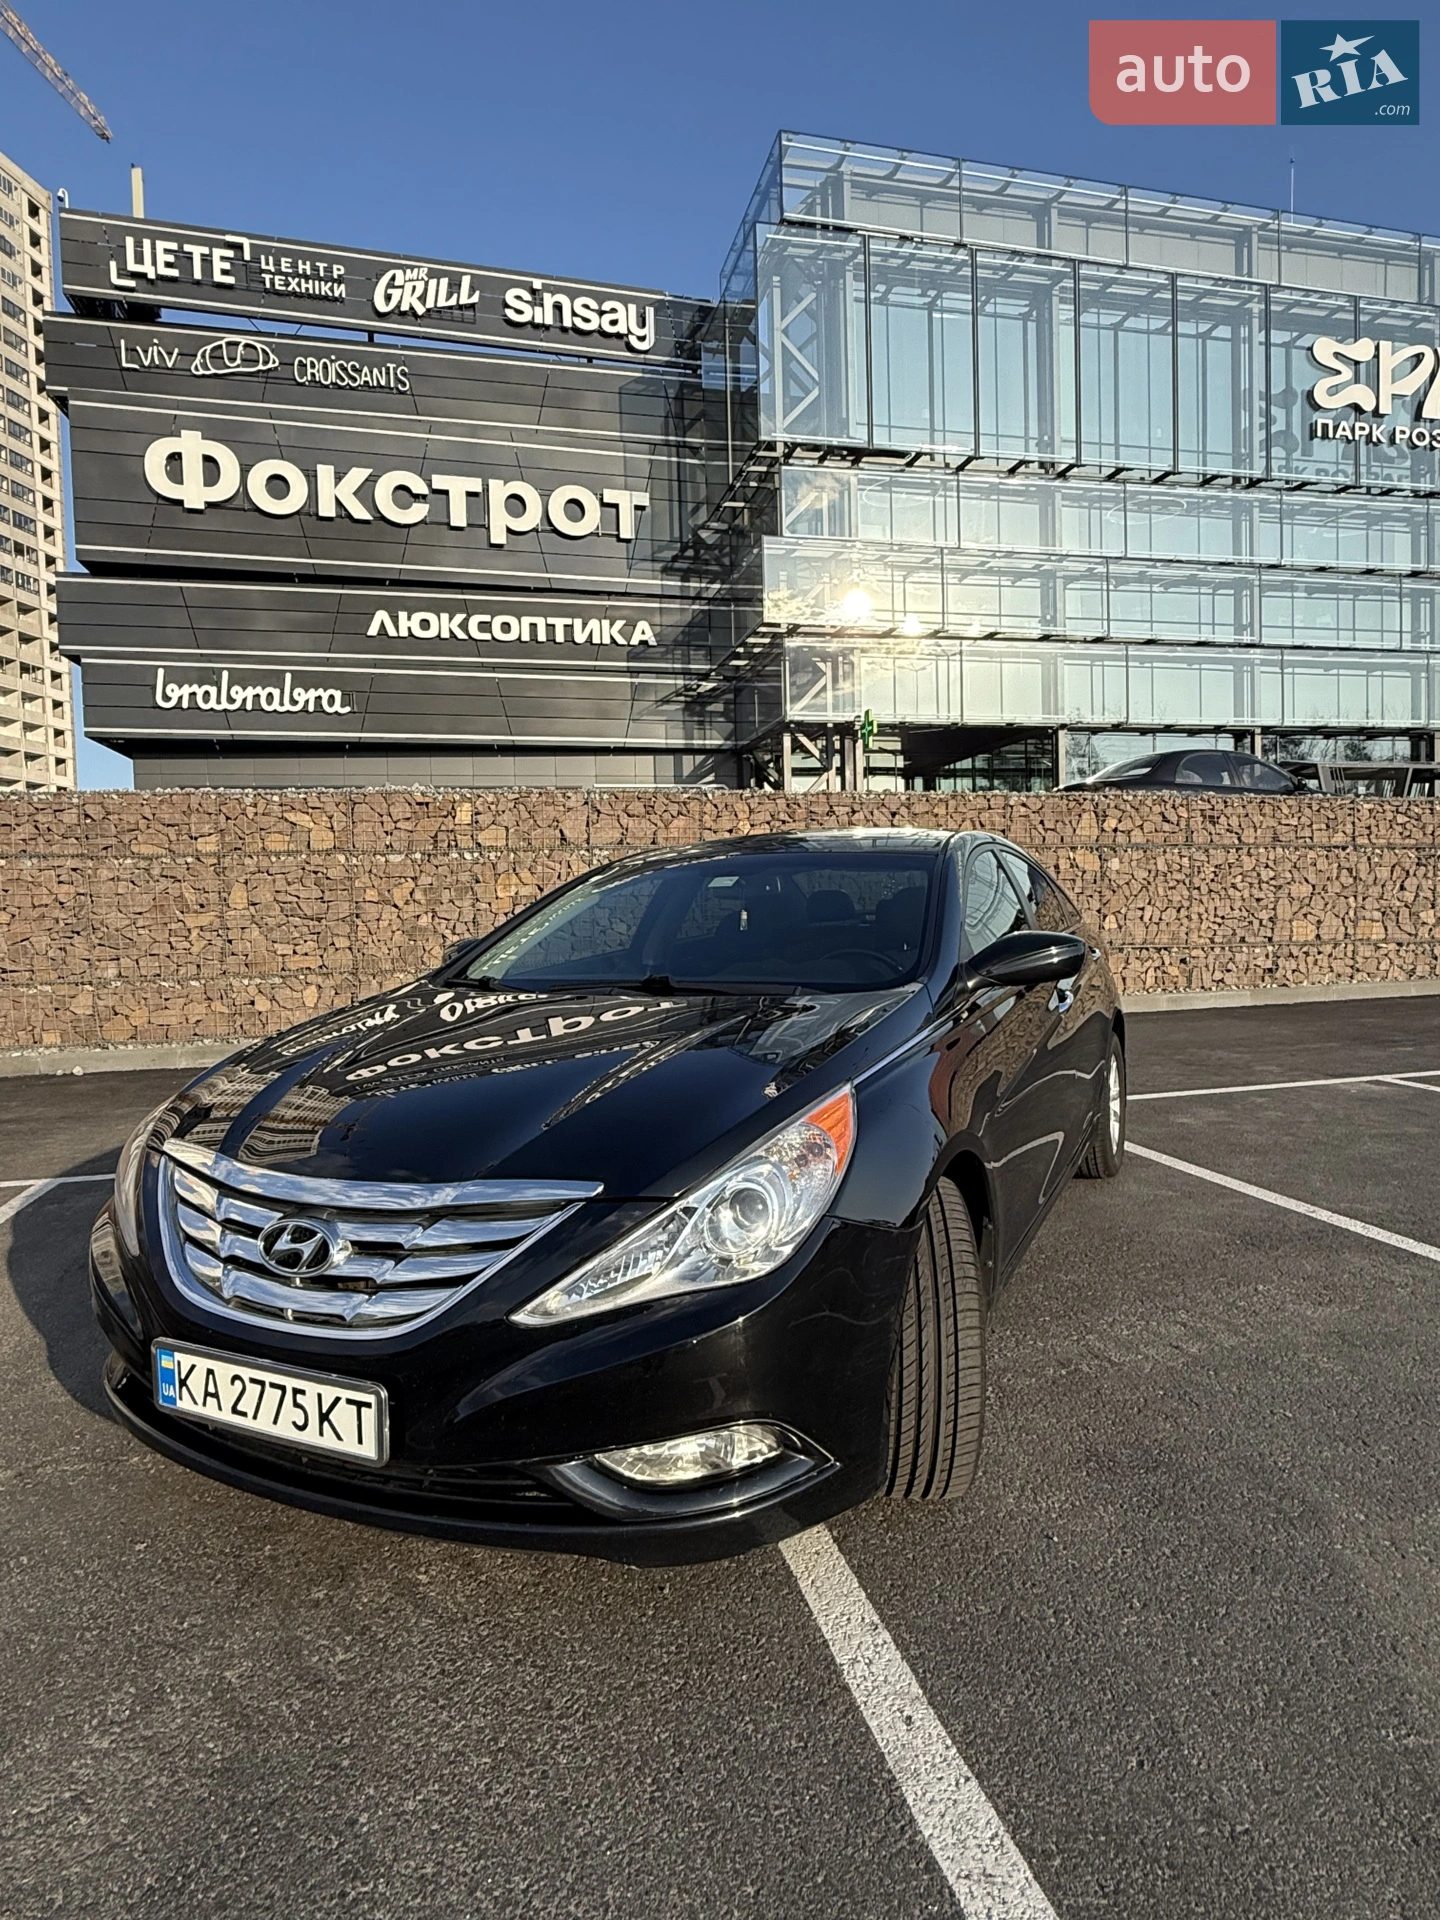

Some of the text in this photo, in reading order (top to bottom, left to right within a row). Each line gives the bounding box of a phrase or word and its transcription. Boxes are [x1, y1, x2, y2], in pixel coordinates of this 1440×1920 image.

[124, 235, 236, 285] ЦЕТЕ
[260, 254, 345, 278] ЦЕНТР
[404, 267, 429, 283] MR
[261, 274, 346, 298] ТЕХНІКИ
[373, 268, 480, 316] GRILL
[504, 278, 655, 351] sinsay
[120, 338, 179, 371] Lviv
[1316, 418, 1387, 443] ПАРК
[143, 429, 650, 546] Фокстрот
[366, 609, 659, 647] ЛЮКСОПТИКА
[155, 667, 352, 715] brabrabra
[162, 1382, 176, 1398] UA
